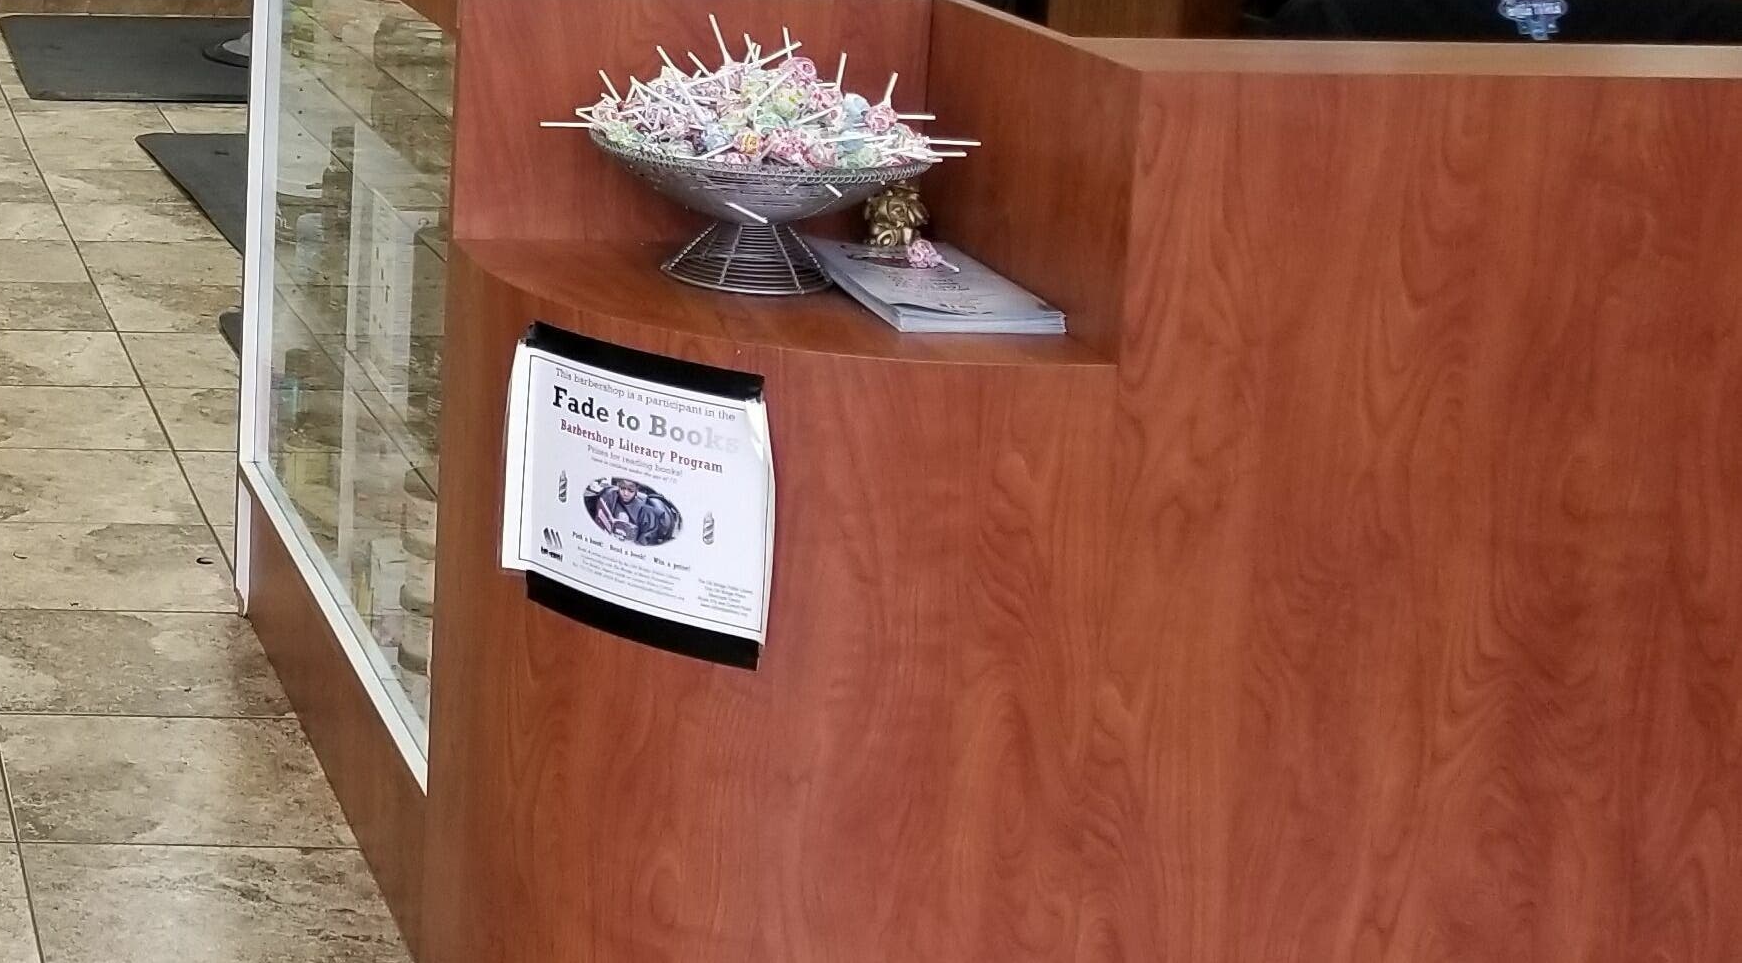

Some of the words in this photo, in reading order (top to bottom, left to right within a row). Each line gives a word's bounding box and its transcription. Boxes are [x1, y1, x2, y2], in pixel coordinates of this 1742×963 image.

[552, 385, 609, 423] Fade
[616, 408, 640, 432] to
[648, 413, 739, 454] Books
[556, 367, 572, 381] This
[574, 373, 625, 398] barbershop
[627, 390, 635, 401] is
[637, 394, 643, 403] a
[645, 396, 702, 415] participant
[704, 408, 715, 419] in
[718, 409, 736, 422] the
[560, 418, 615, 449] Barbershop
[619, 437, 666, 463] Literacy
[670, 450, 723, 474] Program
